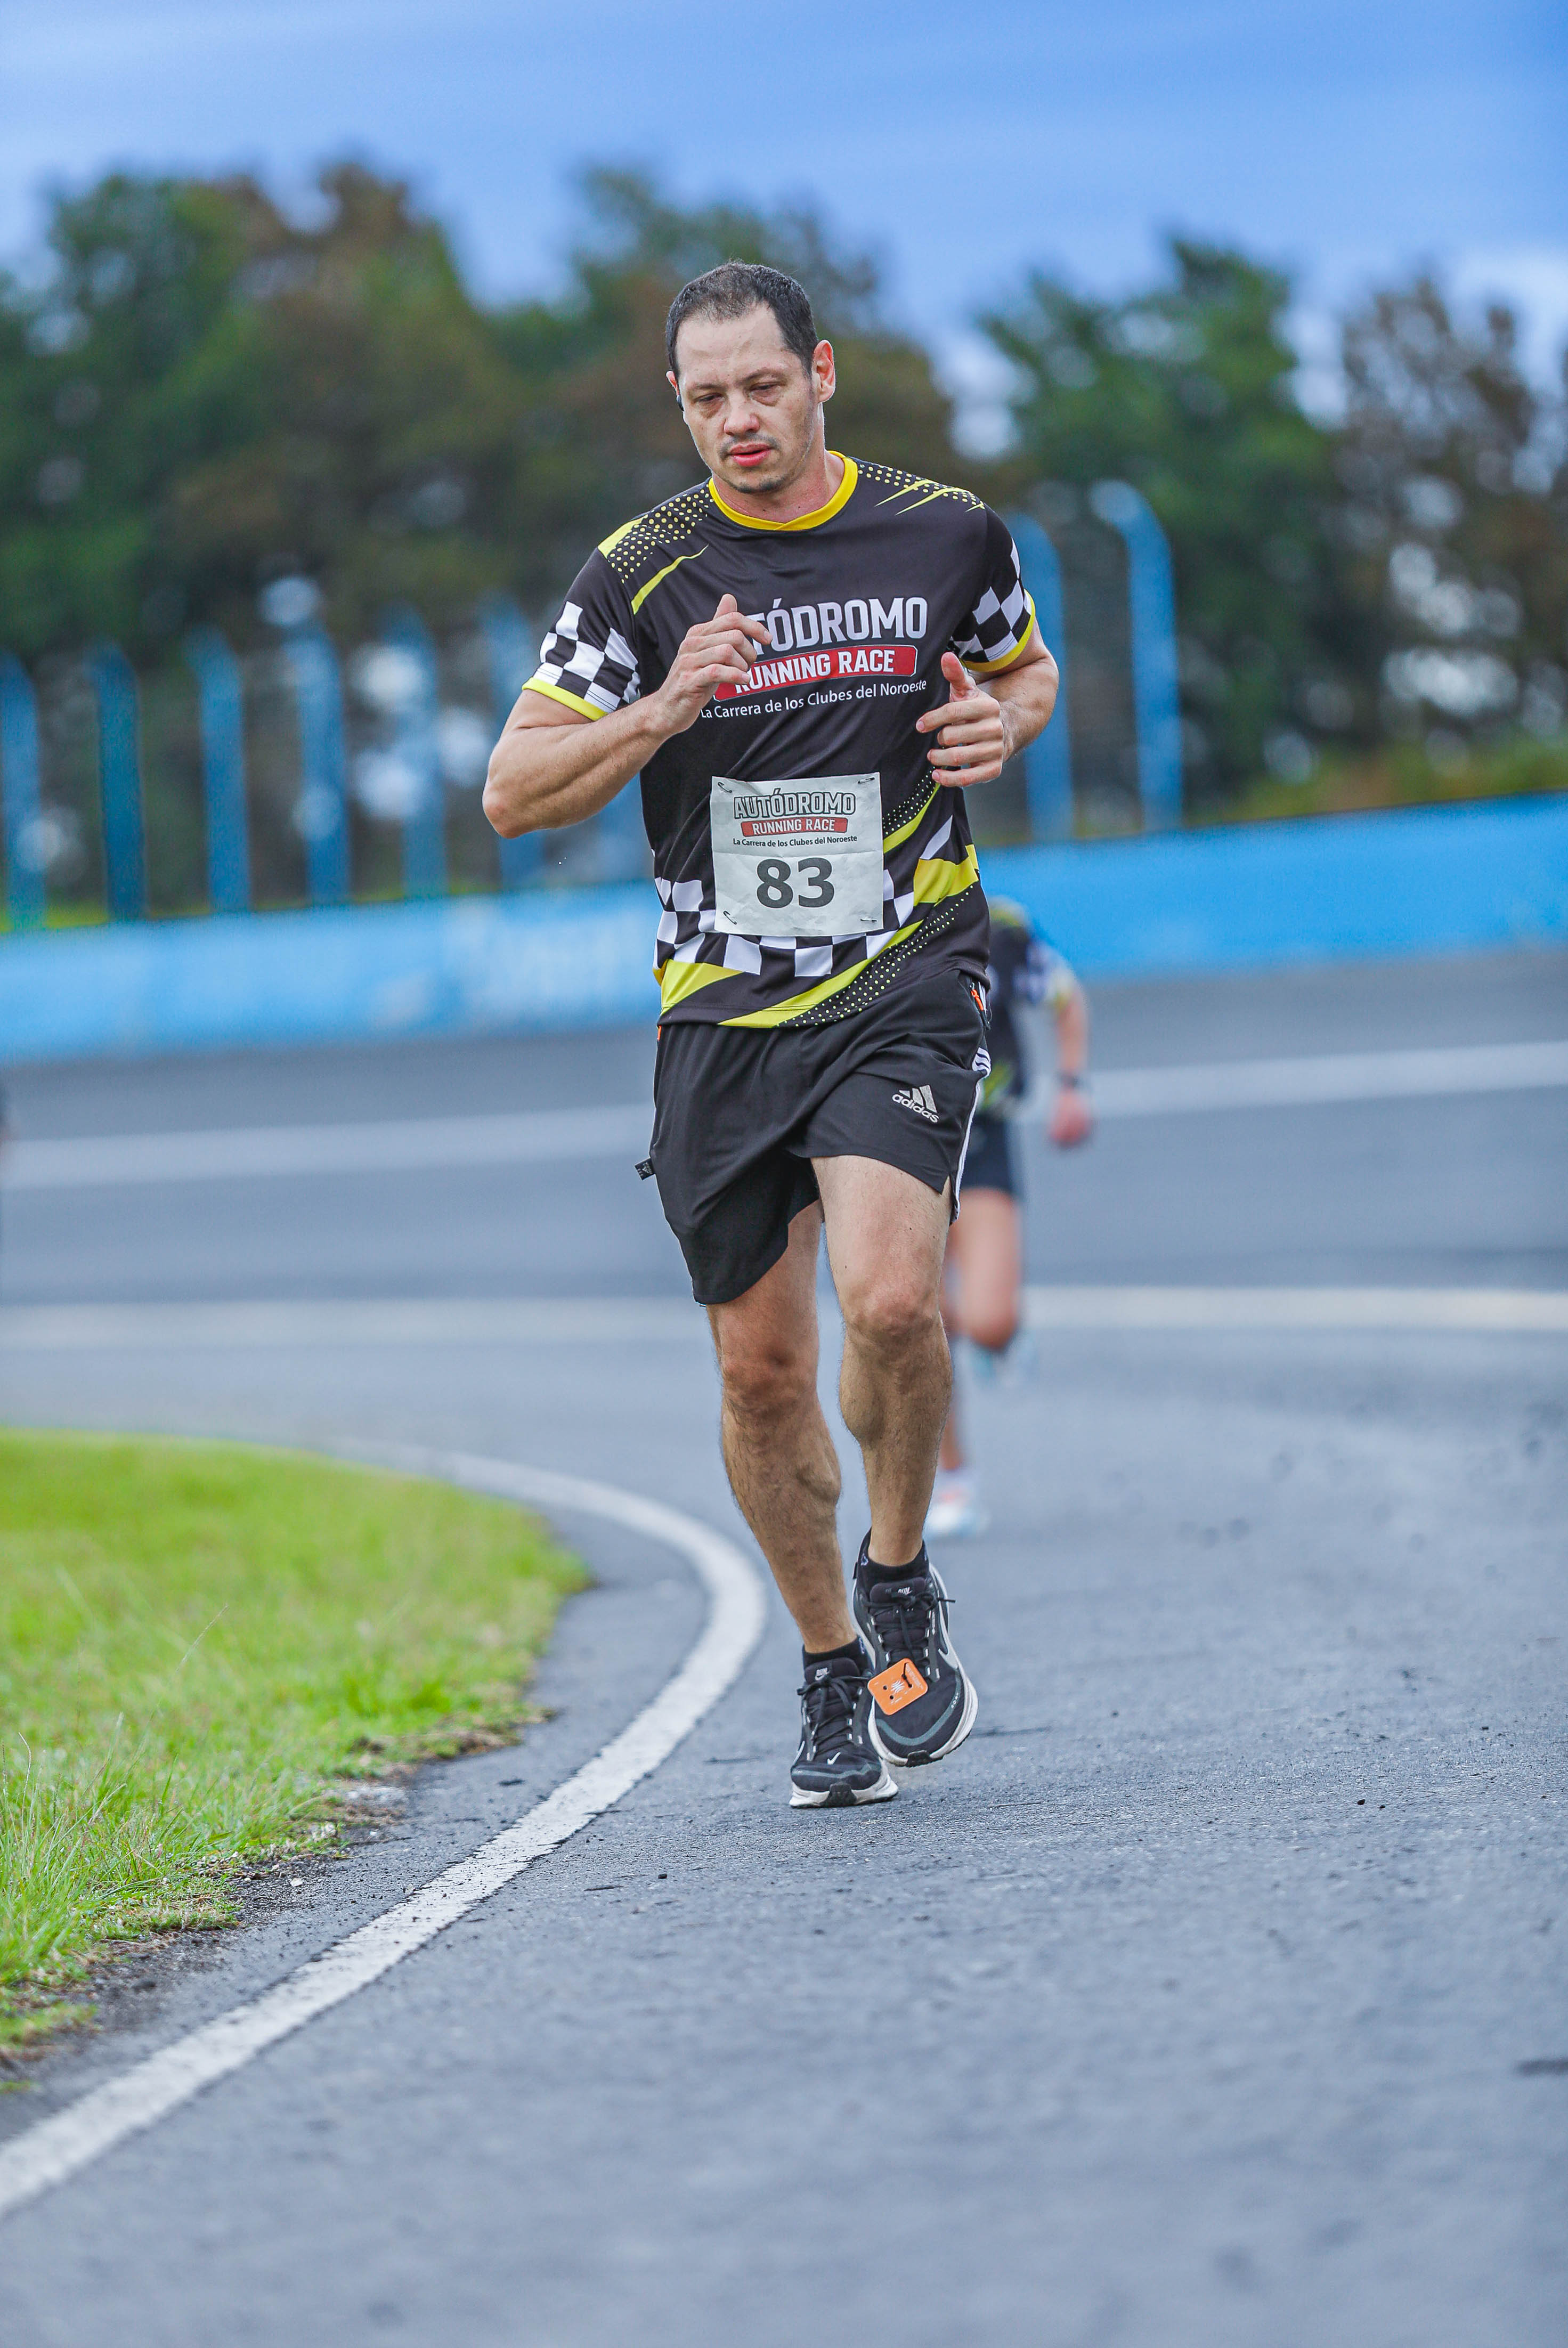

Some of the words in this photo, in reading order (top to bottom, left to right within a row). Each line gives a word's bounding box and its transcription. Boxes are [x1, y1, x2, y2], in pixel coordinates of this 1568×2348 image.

[838, 649, 895, 675] RACE
[701, 709, 712, 718] La
[714, 705, 761, 718] Carrera
[765, 700, 782, 713] de
[785, 697, 804, 711] los
[807, 690, 852, 705] Clubes
[856, 684, 877, 699] del
[880, 680, 927, 696] Noroeste
[734, 788, 856, 819] AUTÓDROMO
[752, 818, 802, 835] RUNNING
[805, 818, 835, 832] RACE
[827, 835, 857, 843] Noroeste
[757, 857, 834, 908] 83
[892, 1094, 939, 1123] adidas
